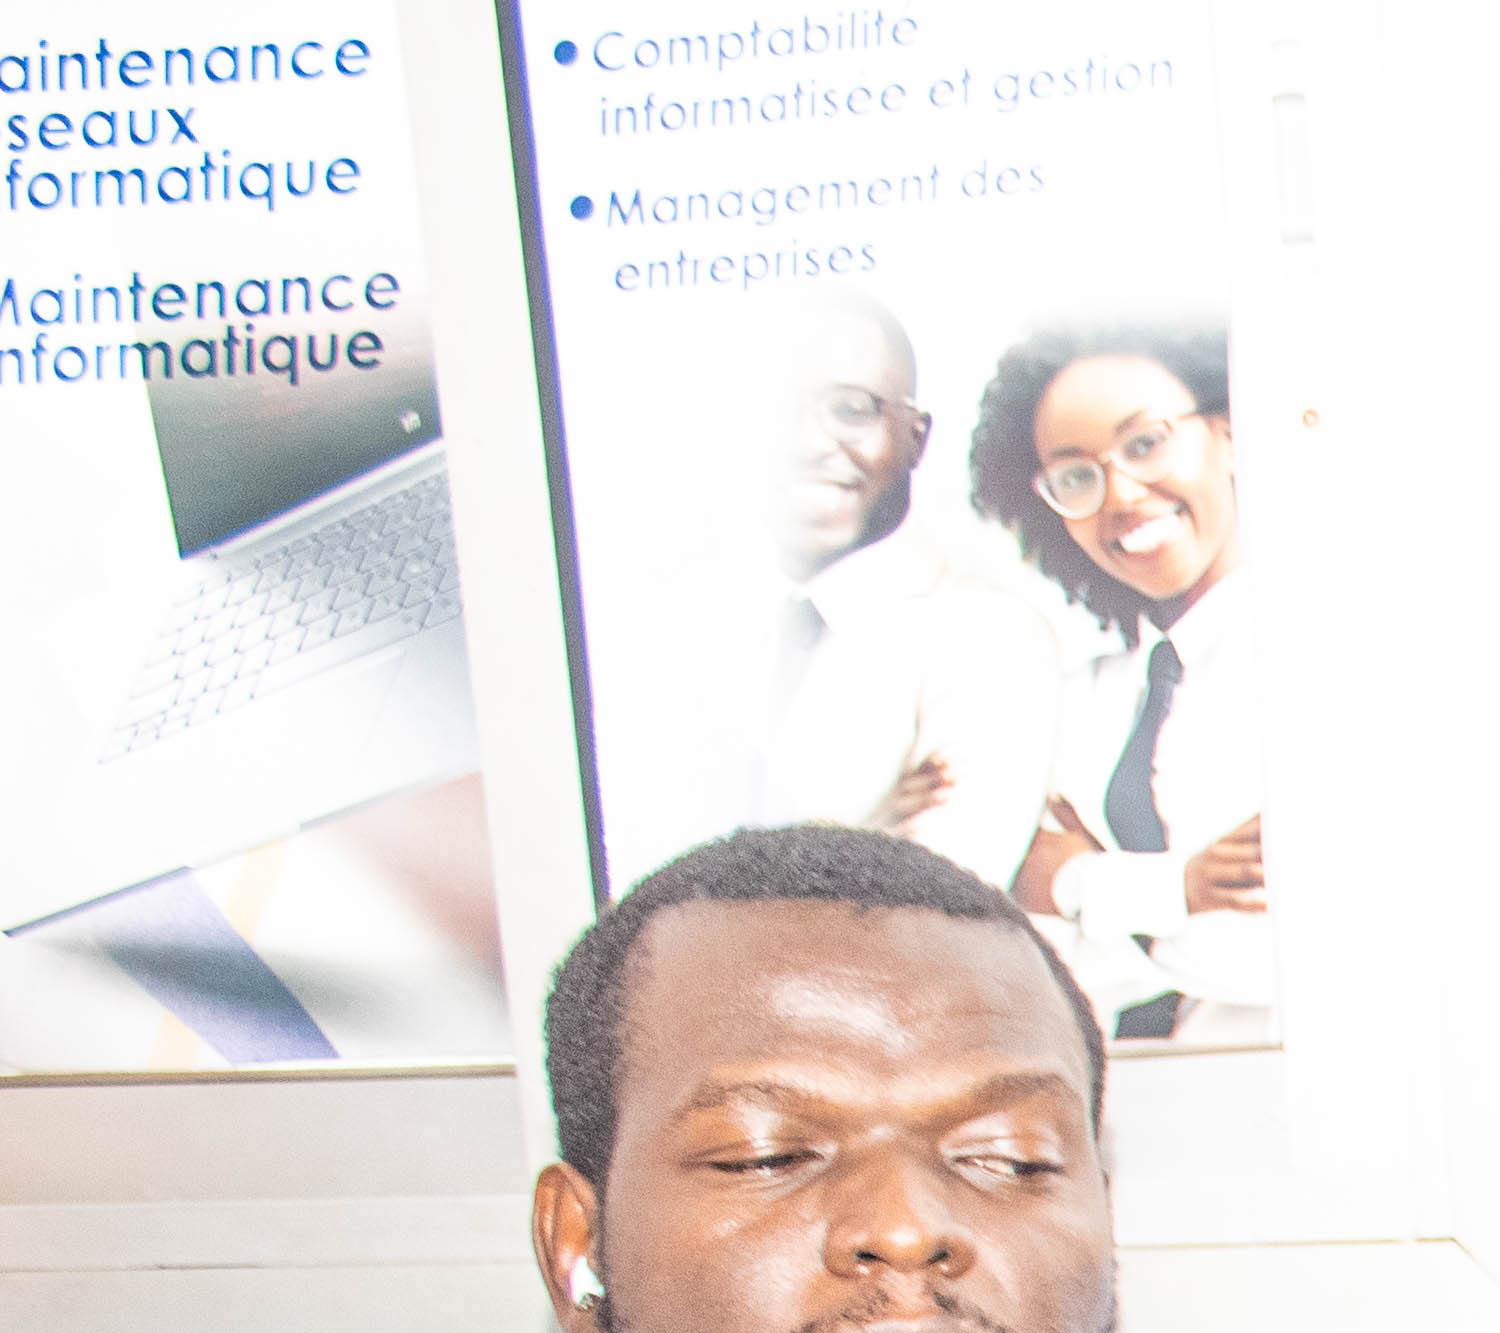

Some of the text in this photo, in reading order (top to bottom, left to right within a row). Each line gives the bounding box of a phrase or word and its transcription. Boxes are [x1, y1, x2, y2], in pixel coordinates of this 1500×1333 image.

[0, 37, 371, 93] aintenance
[929, 69, 970, 108] et
[993, 54, 1174, 114] gestion
[8, 107, 198, 152] seaux
[6, 150, 361, 211] formatique
[606, 159, 1046, 228] Management des
[614, 239, 878, 292] entreprises
[0, 325, 384, 386] nformatique
